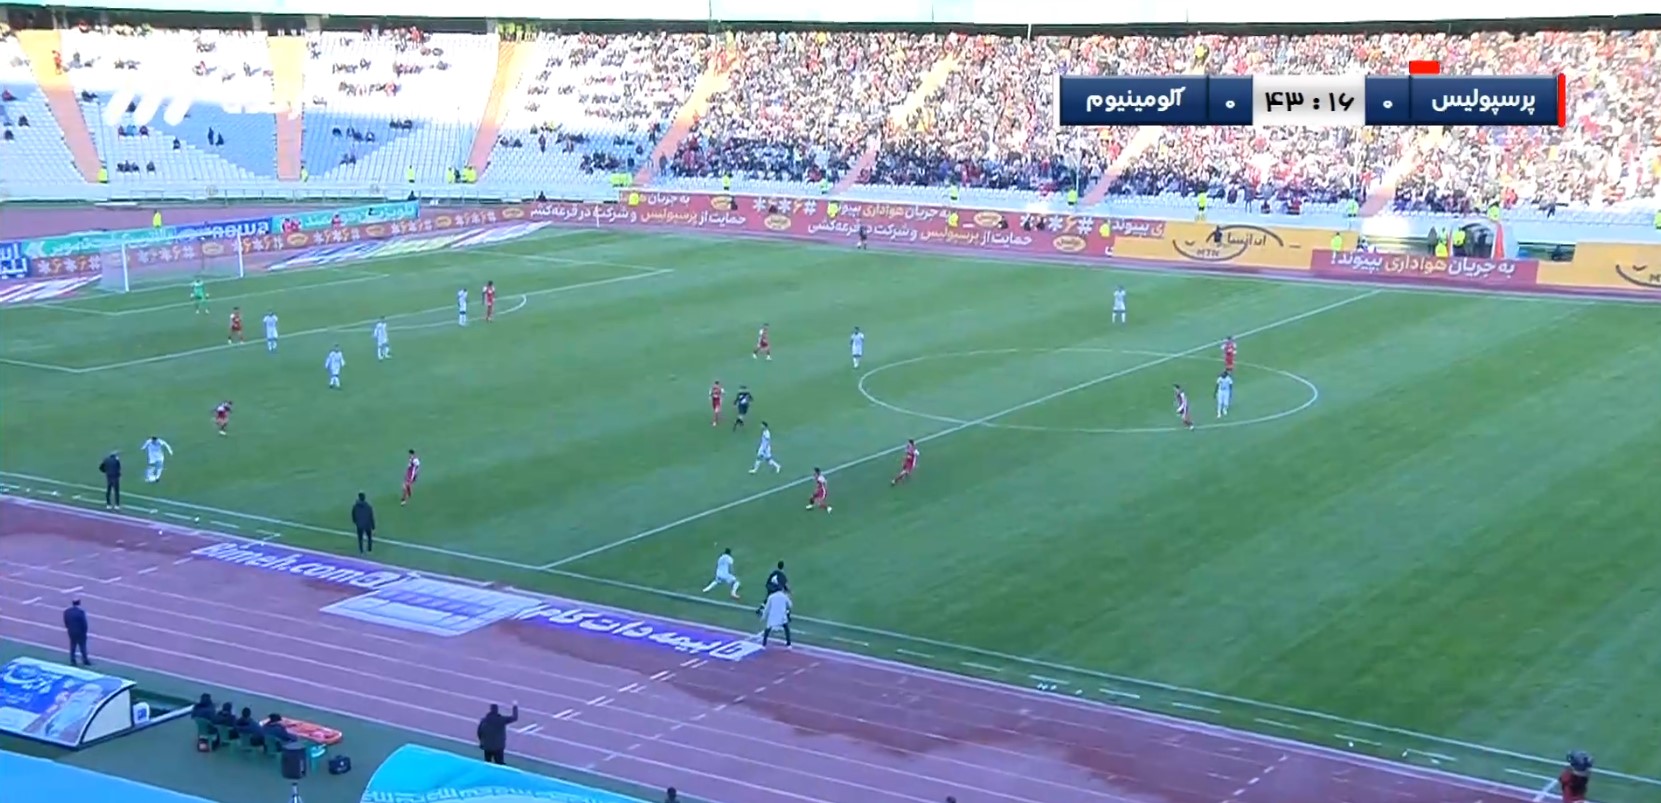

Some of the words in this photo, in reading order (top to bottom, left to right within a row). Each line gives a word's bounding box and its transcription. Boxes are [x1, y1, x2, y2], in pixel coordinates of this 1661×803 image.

[641, 206, 698, 227] پرسپولیس
[698, 207, 708, 226] از
[708, 206, 746, 226] حمایت
[921, 225, 979, 246] پرسپولیس
[980, 230, 991, 246] از
[991, 229, 1033, 248] حمایت
[1331, 251, 1382, 274] بپیوند!
[1385, 255, 1447, 274] هواداری
[1448, 257, 1495, 279] جریان
[1498, 261, 1515, 278] به
